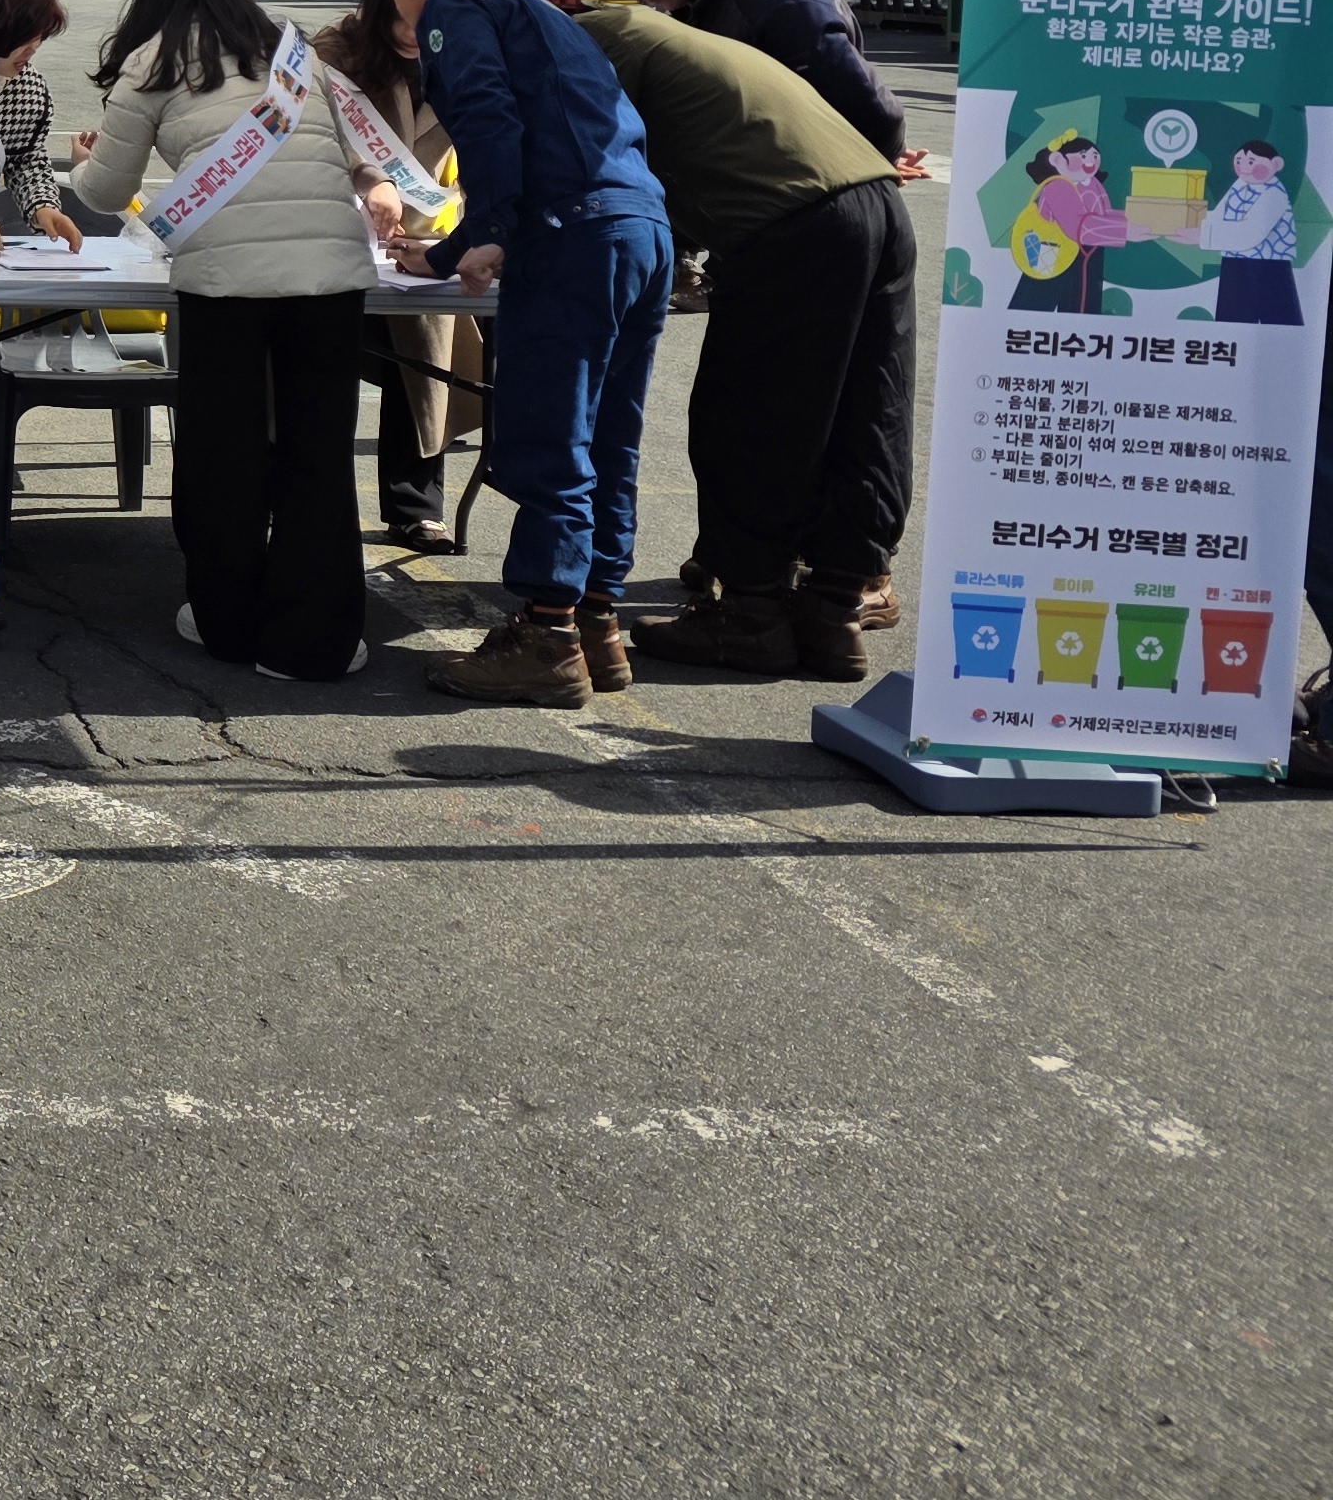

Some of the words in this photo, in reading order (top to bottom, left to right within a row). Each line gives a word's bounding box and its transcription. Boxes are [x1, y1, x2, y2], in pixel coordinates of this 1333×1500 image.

[1046, 17, 1108, 41] 환경을
[1114, 21, 1176, 45] 지키는
[1182, 24, 1223, 47] 작은
[1230, 26, 1276, 50] 습관,
[1081, 45, 1143, 68] 제대로
[1150, 48, 1245, 73] 아시나요?
[341, 98, 378, 140] 무단투기
[367, 136, 392, 162] NO
[231, 128, 265, 169] 쓰레기
[188, 157, 238, 208] 무단투기
[165, 197, 194, 225] NO
[1005, 328, 1114, 360] 분리수거
[1122, 336, 1175, 364] 기본
[1184, 339, 1237, 367] 원칙
[996, 376, 1055, 394] 깨끗하게
[1060, 379, 1089, 397] 씻기
[994, 412, 1052, 431] 섞지말고
[1057, 416, 1115, 434] 분리하기
[1008, 395, 1055, 413] 음식물,
[1061, 398, 1108, 416] 기름기,
[1114, 401, 1171, 420] 이물질은
[1176, 405, 1237, 423] 제거해요.
[991, 448, 1035, 466] 부피는
[1039, 451, 1083, 469] 줄이기
[1005, 431, 1035, 448] 다른
[1039, 433, 1083, 451] 재질이
[1087, 436, 1116, 453] 섞여
[1122, 438, 1164, 456] 있으면
[1169, 441, 1227, 460] 재활용이
[1232, 445, 1291, 463] 어려워요.
[1002, 468, 1049, 485] 페트병,
[1055, 471, 1116, 490] 종이박스,
[1121, 475, 1136, 491] 캔
[1141, 476, 1170, 493] 등은
[1174, 478, 1236, 496] 압축해요.
[991, 520, 1100, 552] 분리수거
[1107, 527, 1188, 558] 항목별
[1196, 533, 1249, 561] 정리
[1133, 582, 1176, 599] 유리병
[991, 710, 1034, 728] 거제시
[1068, 715, 1238, 741] 거제외국인근로자지원센터
